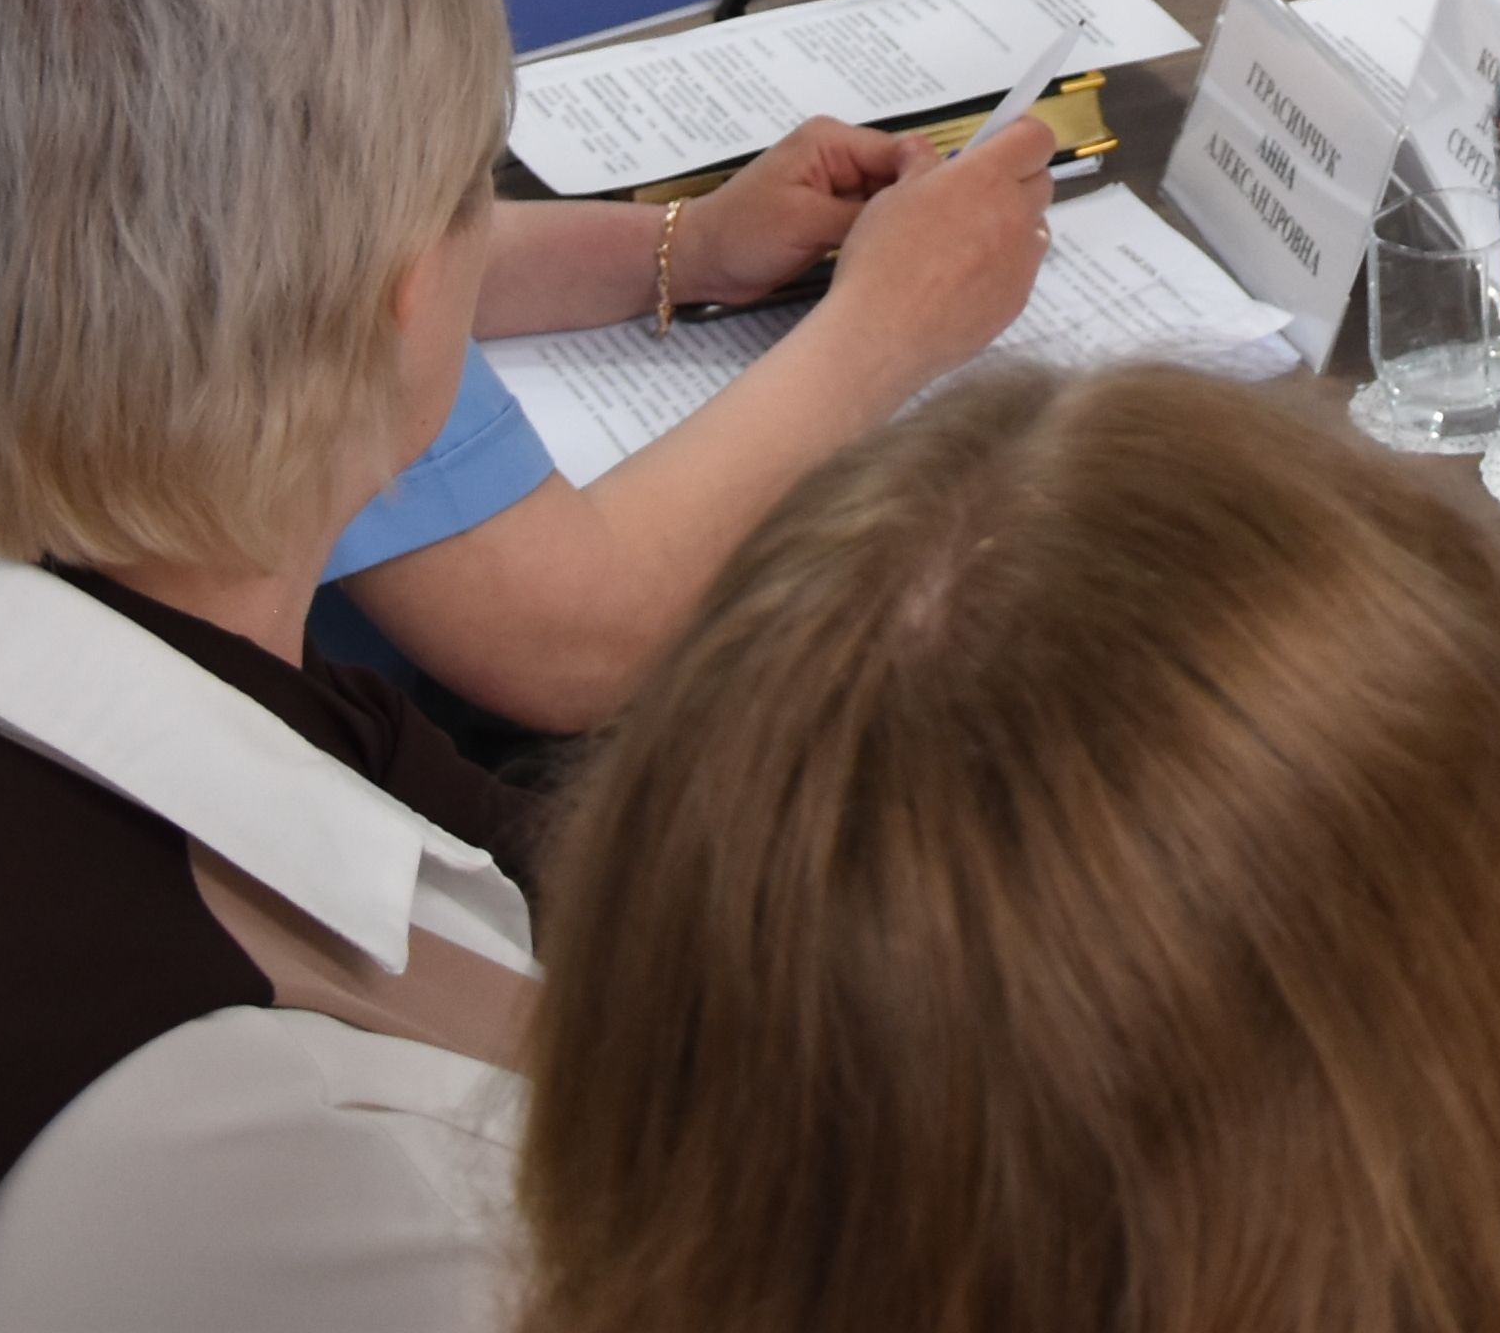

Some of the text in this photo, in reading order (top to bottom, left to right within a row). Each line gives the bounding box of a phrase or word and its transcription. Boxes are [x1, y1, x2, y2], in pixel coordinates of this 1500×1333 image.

[1246, 61, 1341, 178] ГЕРАСИМЧУК
[1255, 135, 1297, 191] АННА
[1204, 133, 1322, 277] АЛЕКСАНДРОВНА
